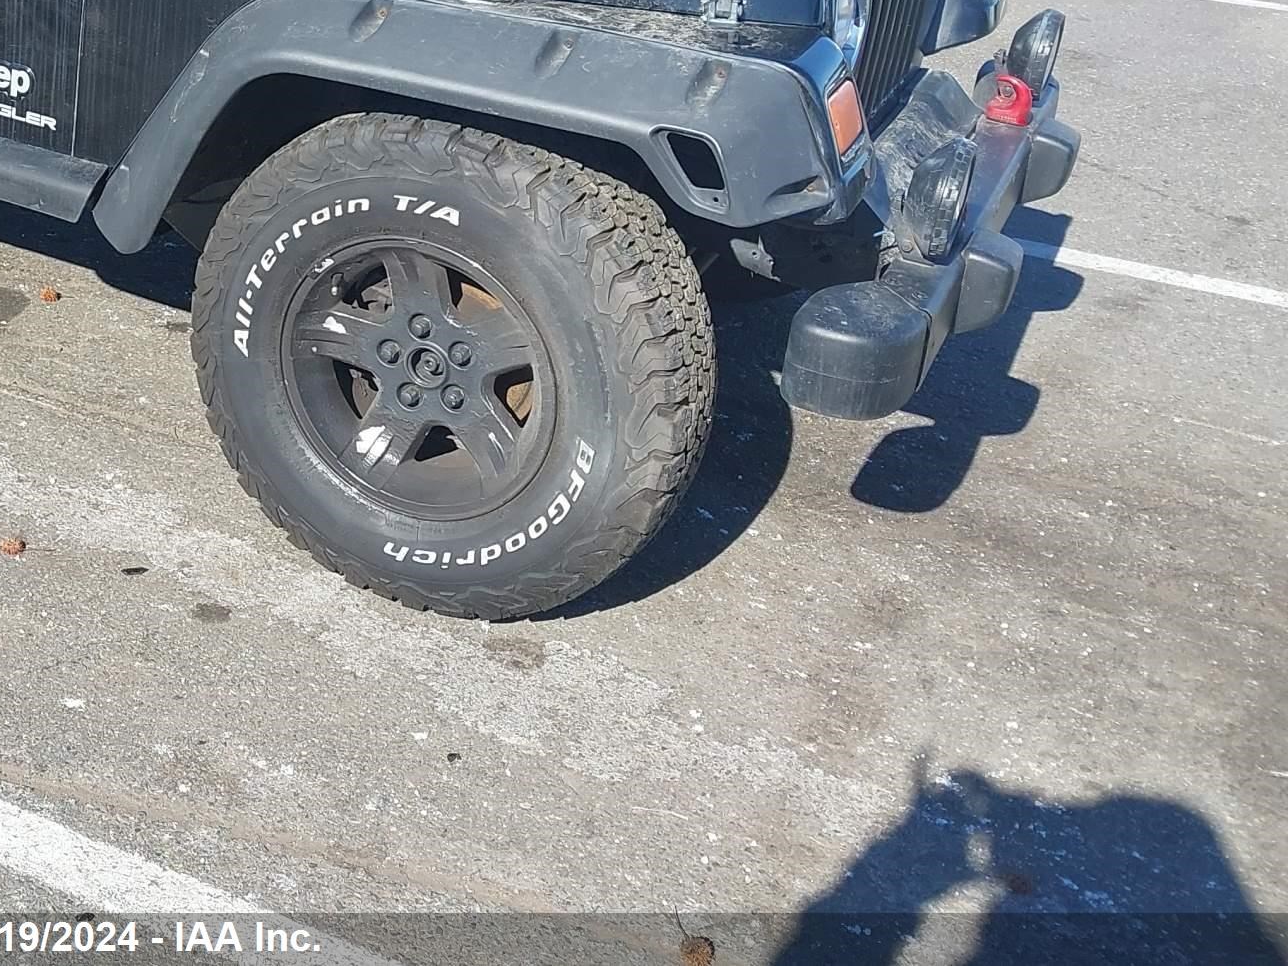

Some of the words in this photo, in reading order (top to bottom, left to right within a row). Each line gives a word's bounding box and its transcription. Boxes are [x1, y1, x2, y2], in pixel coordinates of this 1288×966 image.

[232, 194, 371, 358] All-Terrain
[391, 193, 462, 228] T/A
[382, 438, 593, 568] BFGoodrich
